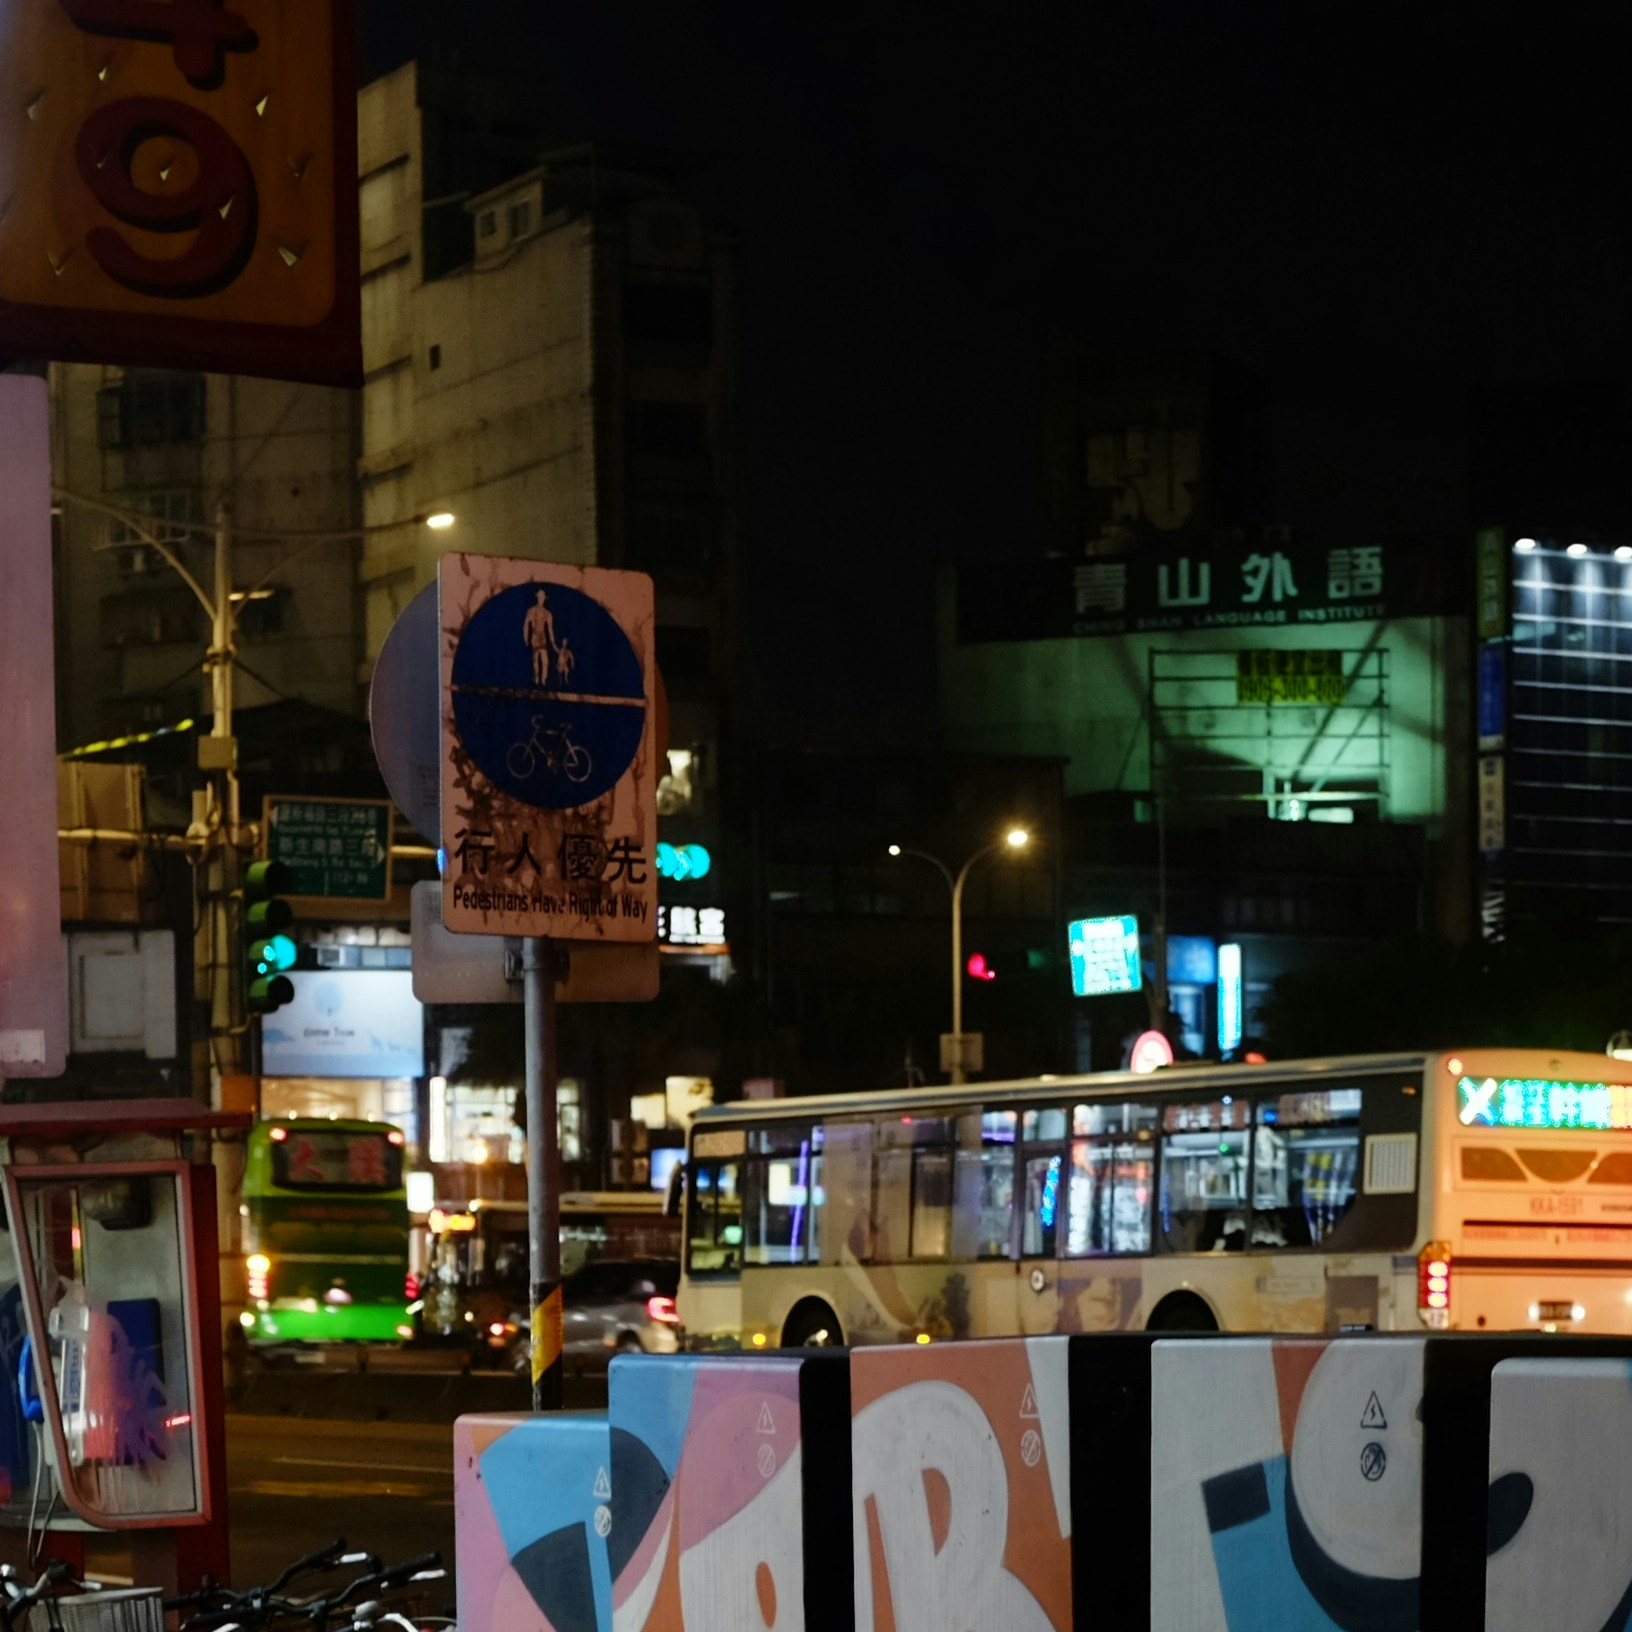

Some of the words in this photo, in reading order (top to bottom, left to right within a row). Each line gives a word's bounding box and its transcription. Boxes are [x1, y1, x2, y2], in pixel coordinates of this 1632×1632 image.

[1073, 545, 1384, 614] 青山外語
[1193, 609, 1289, 627] LANGUAGE
[1298, 603, 1386, 621] INSTITUTE
[454, 828, 647, 884] 行人優先
[453, 884, 528, 913] Pedestrians
[532, 890, 564, 914] Have
[569, 892, 603, 923] Right
[604, 894, 618, 918] of
[622, 894, 648, 925] Way
